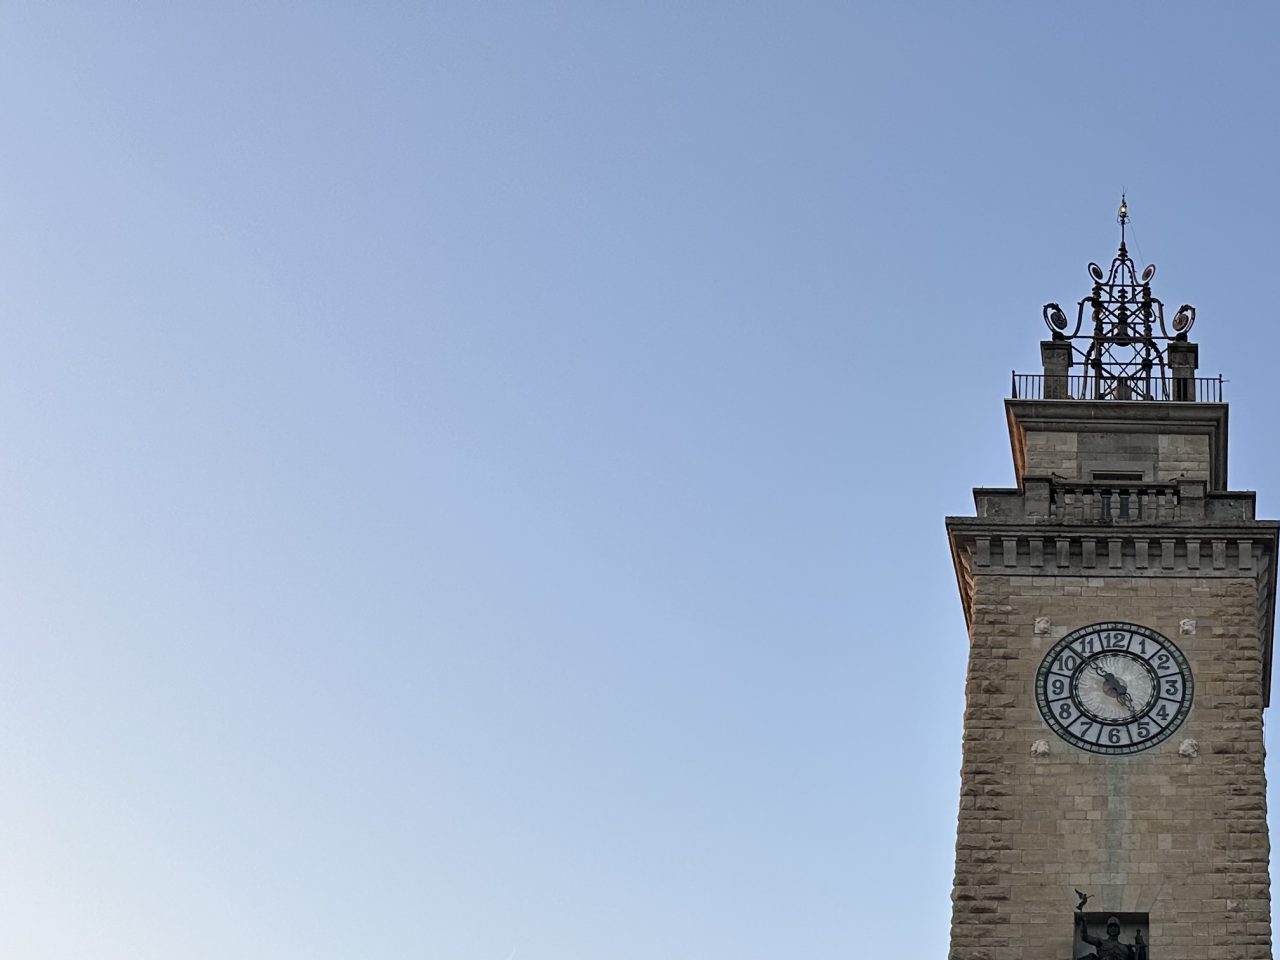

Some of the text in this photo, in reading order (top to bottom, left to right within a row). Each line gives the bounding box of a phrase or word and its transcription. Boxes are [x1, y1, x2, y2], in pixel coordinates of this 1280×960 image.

[1079, 637, 1094, 654] 11
[1104, 632, 1126, 649] 12
[1138, 638, 1146, 655] 1
[1056, 655, 1077, 671] 10
[1157, 653, 1170, 670] 2
[1051, 679, 1065, 695] 9
[1165, 679, 1179, 695] 3
[1058, 703, 1072, 720] 8
[1156, 704, 1169, 721] 4
[1080, 721, 1094, 738] 7
[1108, 728, 1121, 744] 6
[1136, 722, 1150, 738] 5
